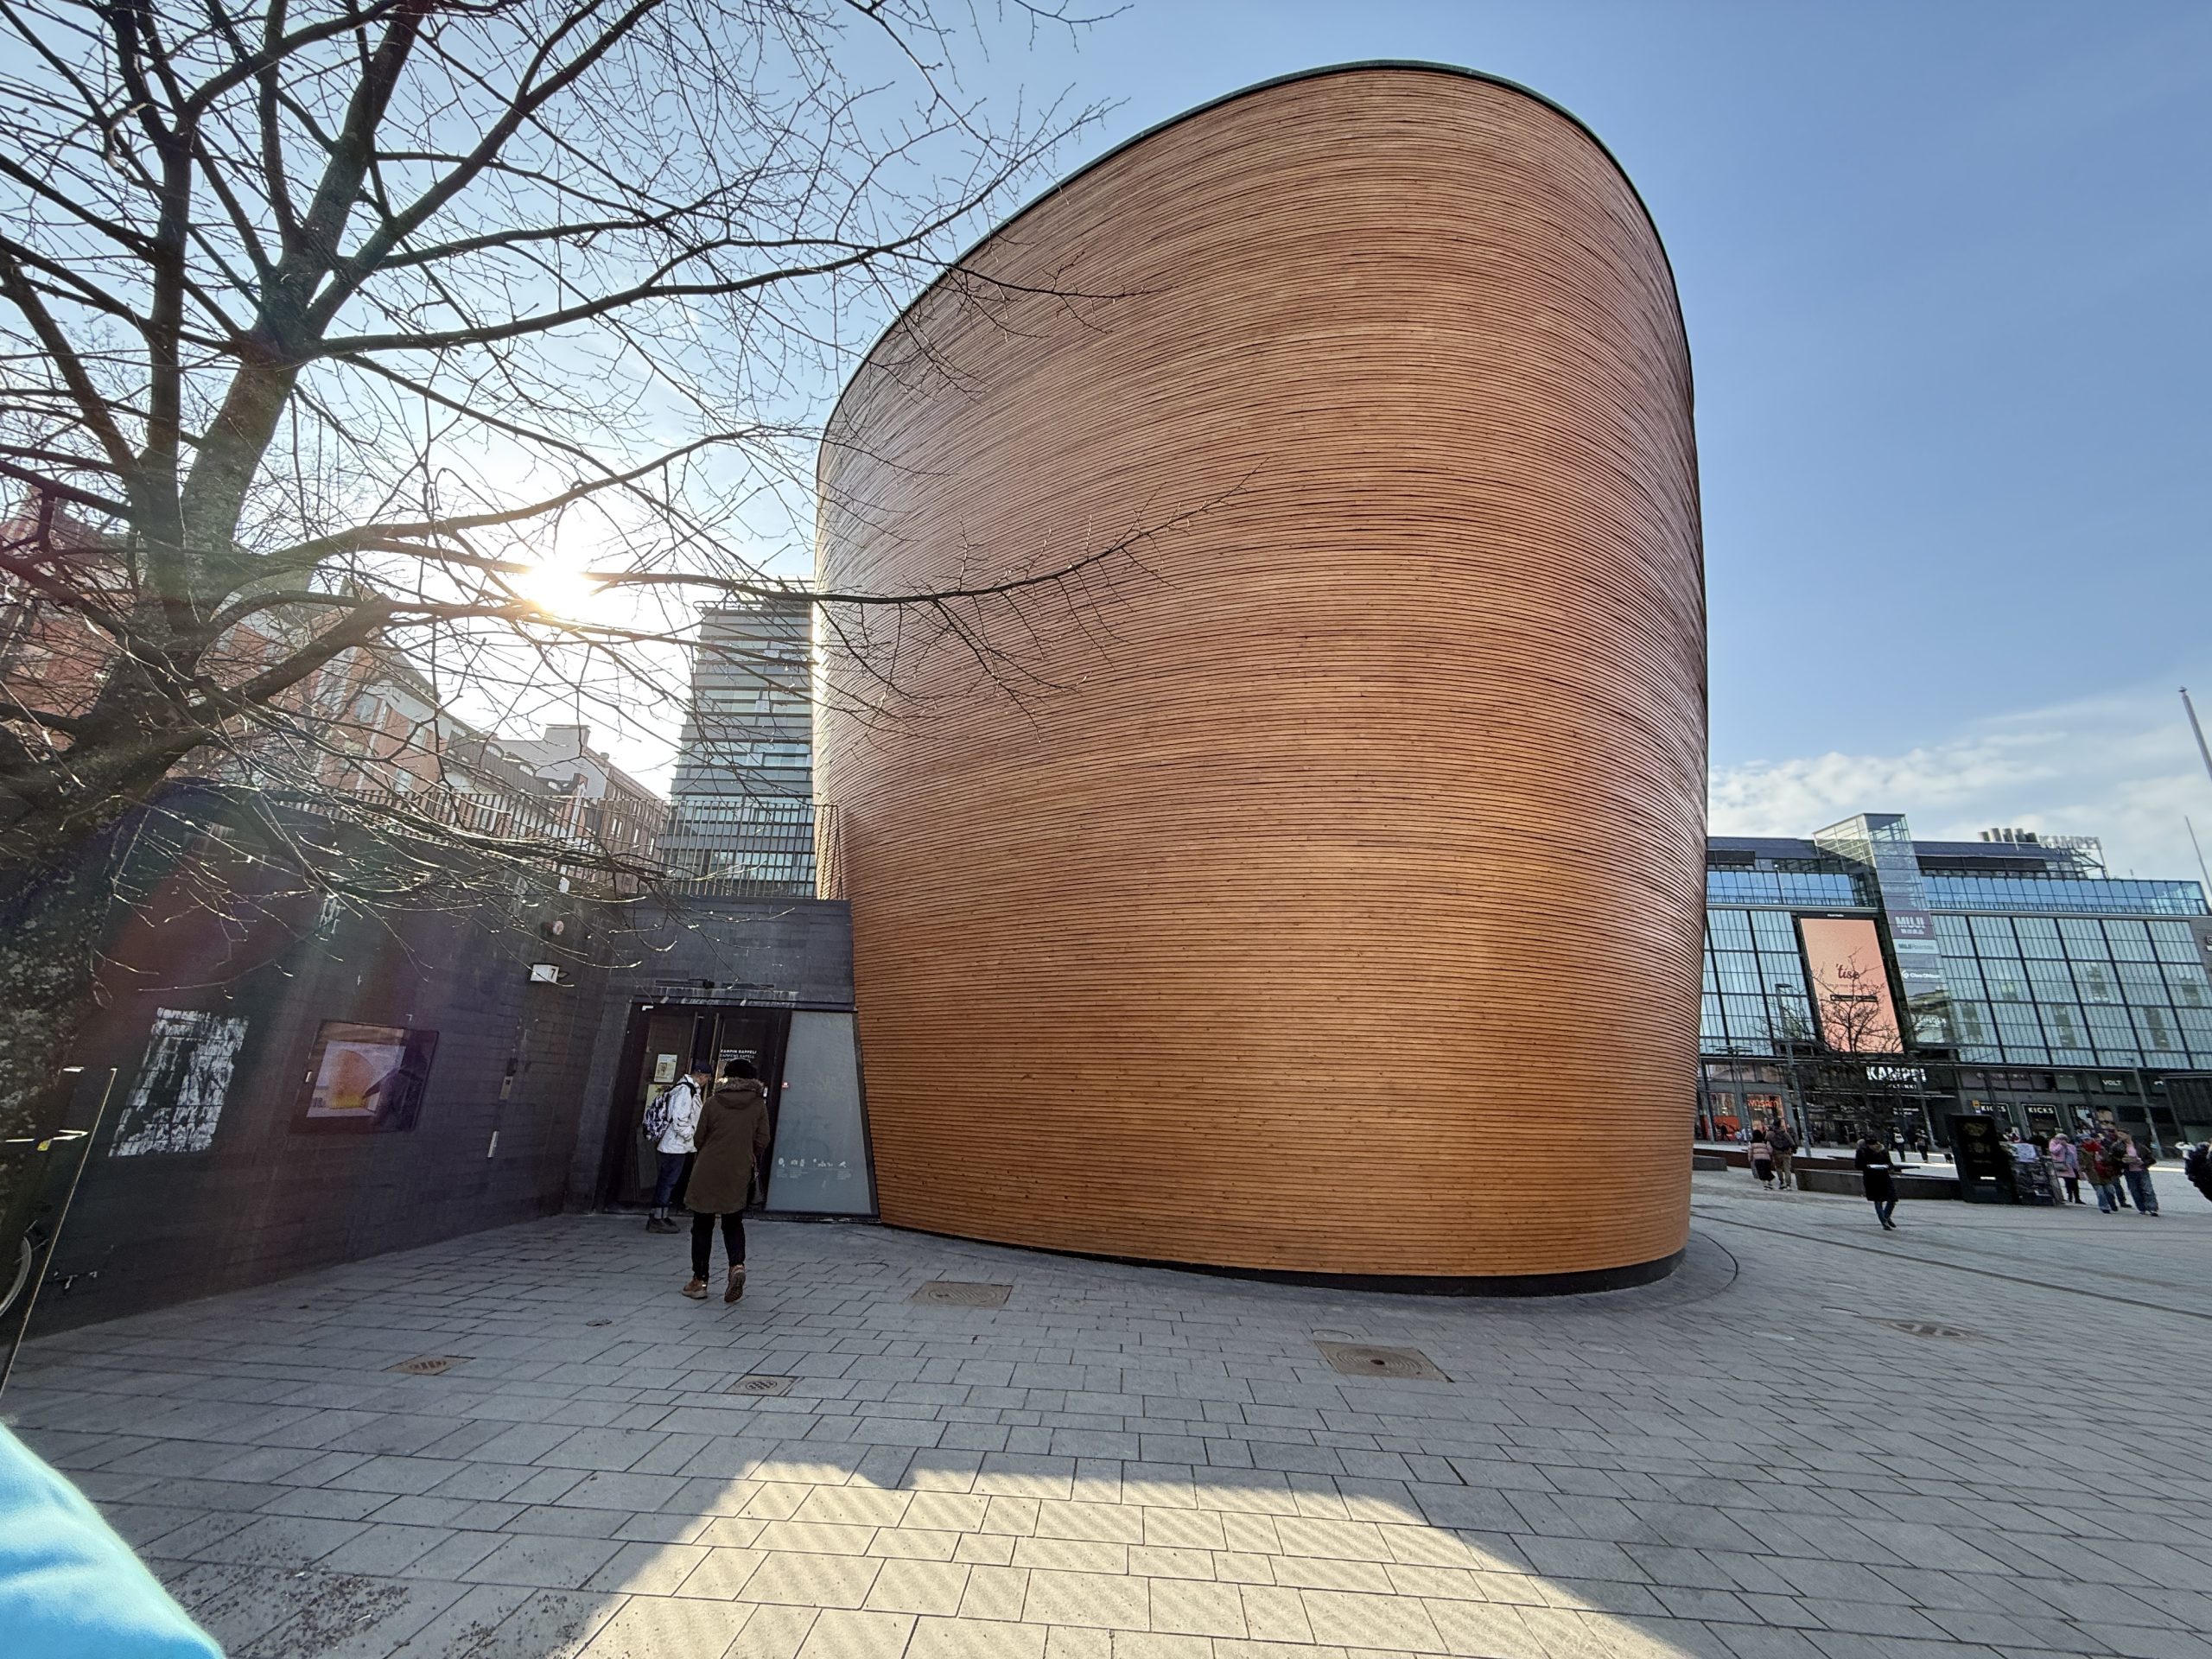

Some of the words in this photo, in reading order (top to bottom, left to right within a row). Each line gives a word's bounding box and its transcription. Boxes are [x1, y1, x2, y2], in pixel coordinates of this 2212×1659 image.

[2038, 835, 2102, 850] KAMPPI
[1895, 916, 1925, 929] MUJI
[1866, 1066, 1927, 1082] KAMPPI
